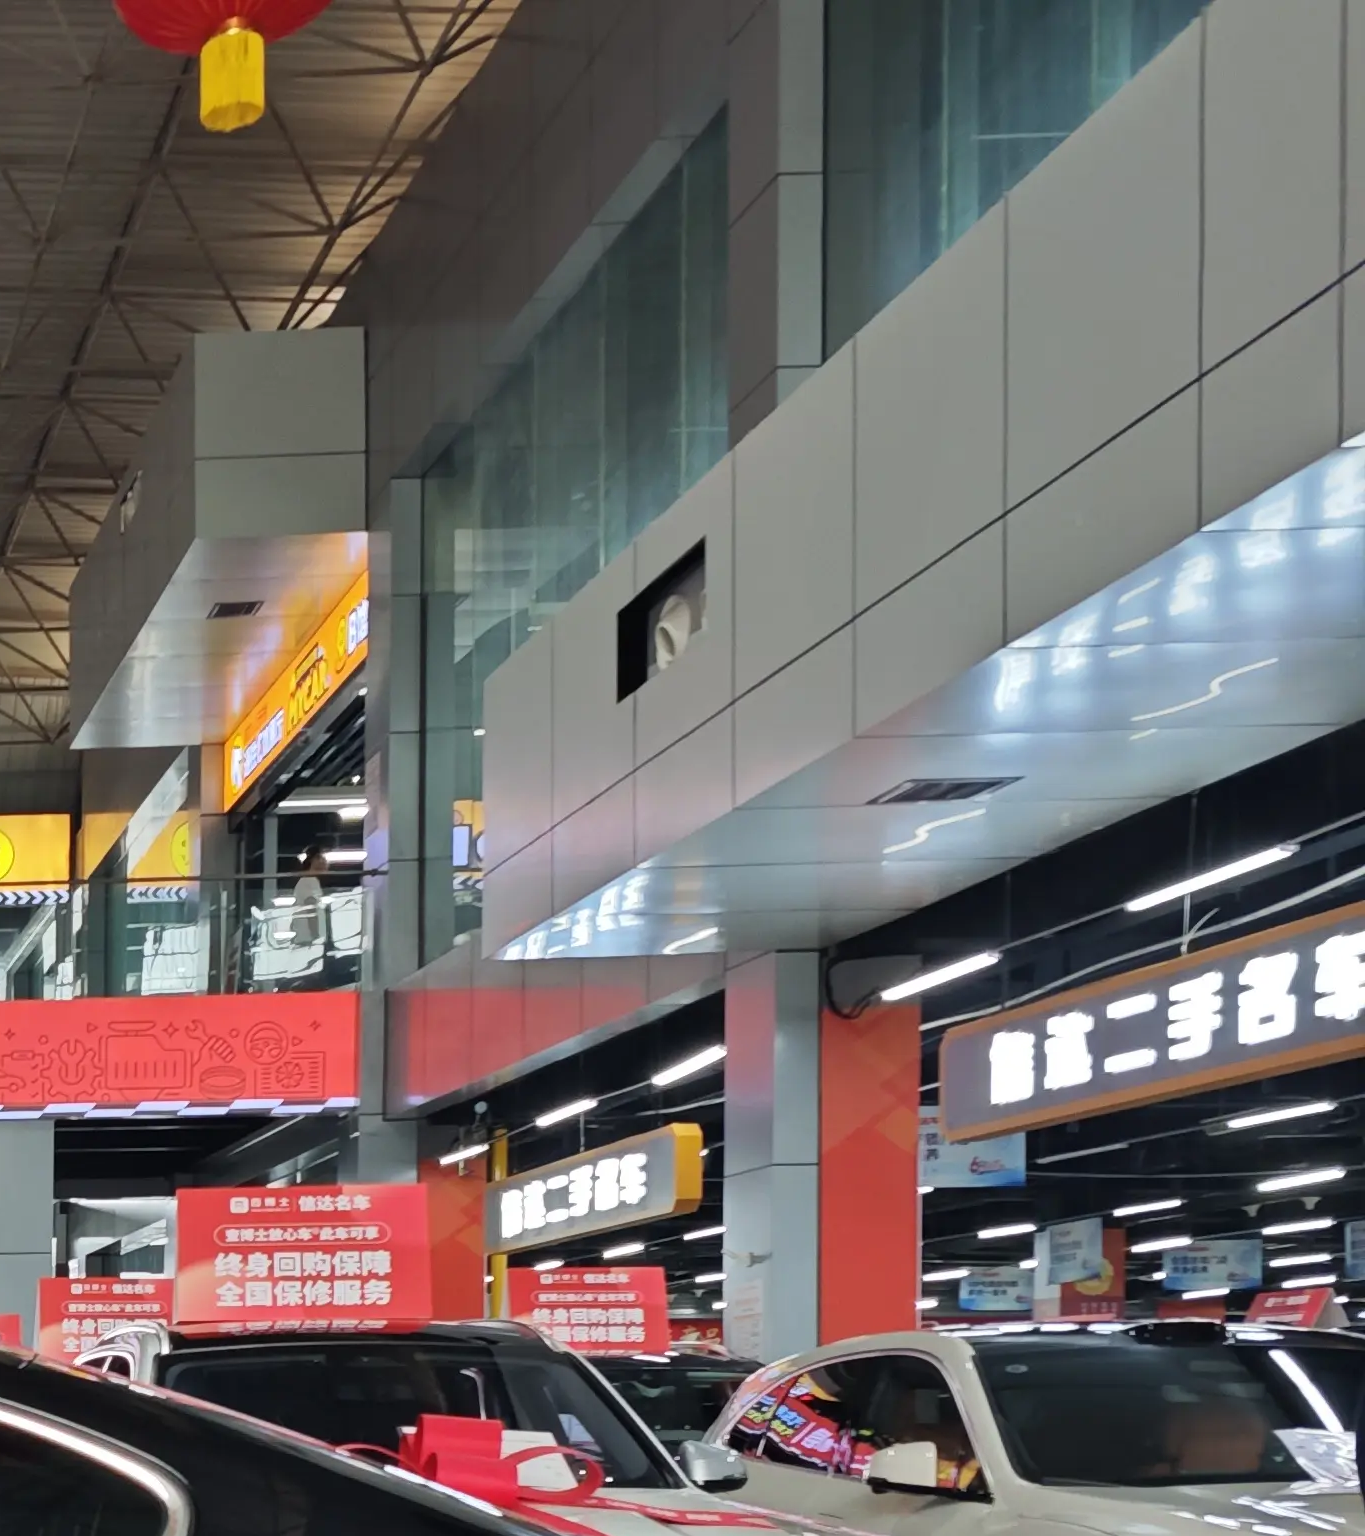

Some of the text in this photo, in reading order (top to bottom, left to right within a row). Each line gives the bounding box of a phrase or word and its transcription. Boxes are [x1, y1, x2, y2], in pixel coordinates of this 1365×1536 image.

[215, 1250, 393, 1278] 终身回购保障
[216, 1279, 393, 1308] 全国保修服务
